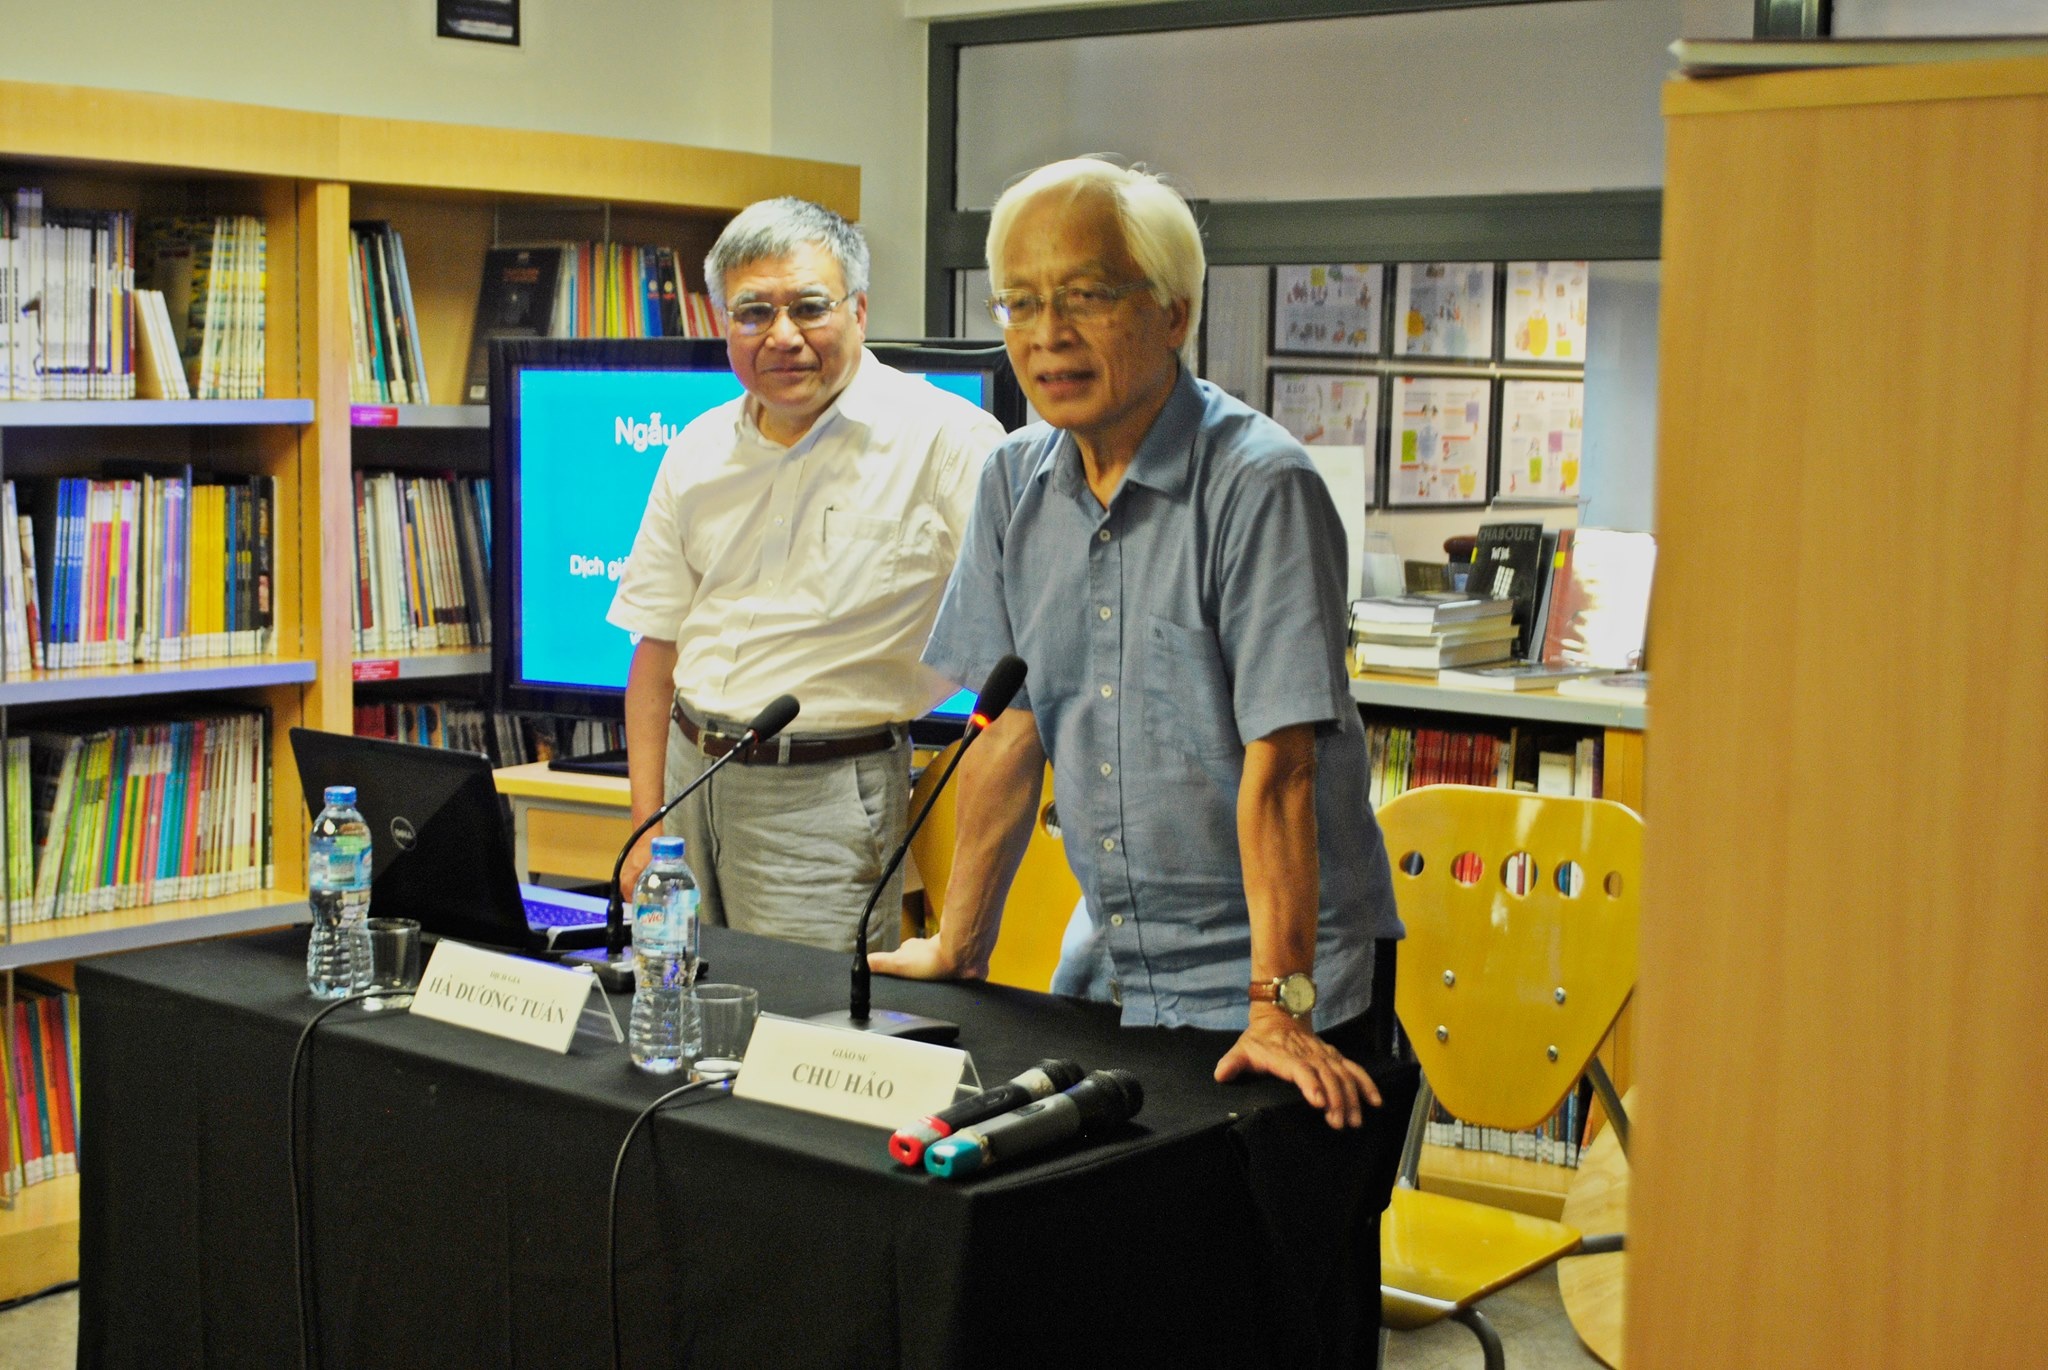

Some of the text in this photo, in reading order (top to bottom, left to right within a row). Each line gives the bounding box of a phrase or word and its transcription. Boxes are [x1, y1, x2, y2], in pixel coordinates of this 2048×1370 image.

[615, 411, 678, 453] Ngẫu
[569, 554, 605, 579] Dịch
[454, 982, 519, 1013] DƯƠNG
[792, 1062, 895, 1100] CHU HẢO
